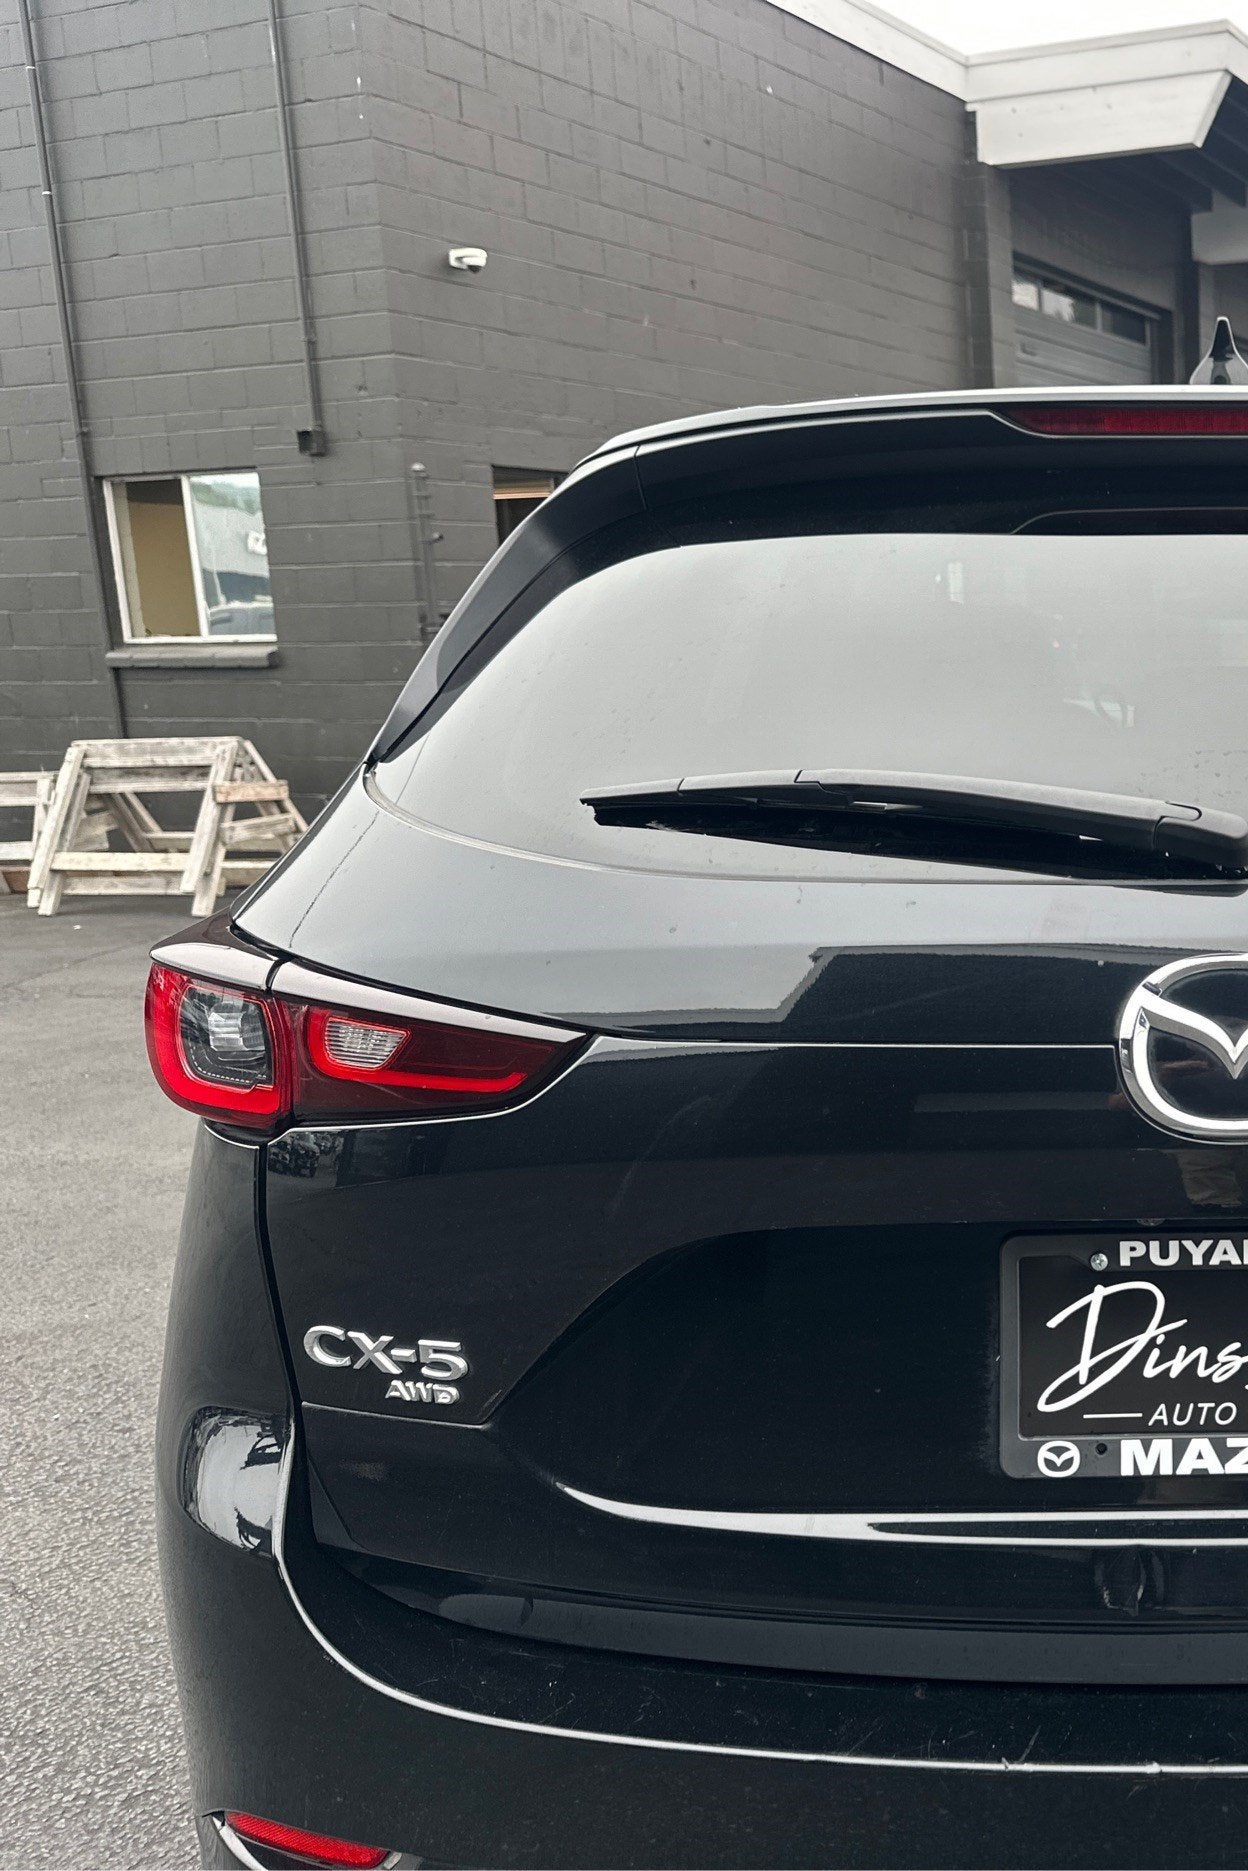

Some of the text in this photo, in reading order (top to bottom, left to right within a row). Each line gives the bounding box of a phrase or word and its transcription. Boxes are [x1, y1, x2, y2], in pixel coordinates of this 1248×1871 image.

[303, 1325, 468, 1381] CX-5
[385, 1379, 460, 1404] AWD
[1148, 1401, 1237, 1426] AUTO
